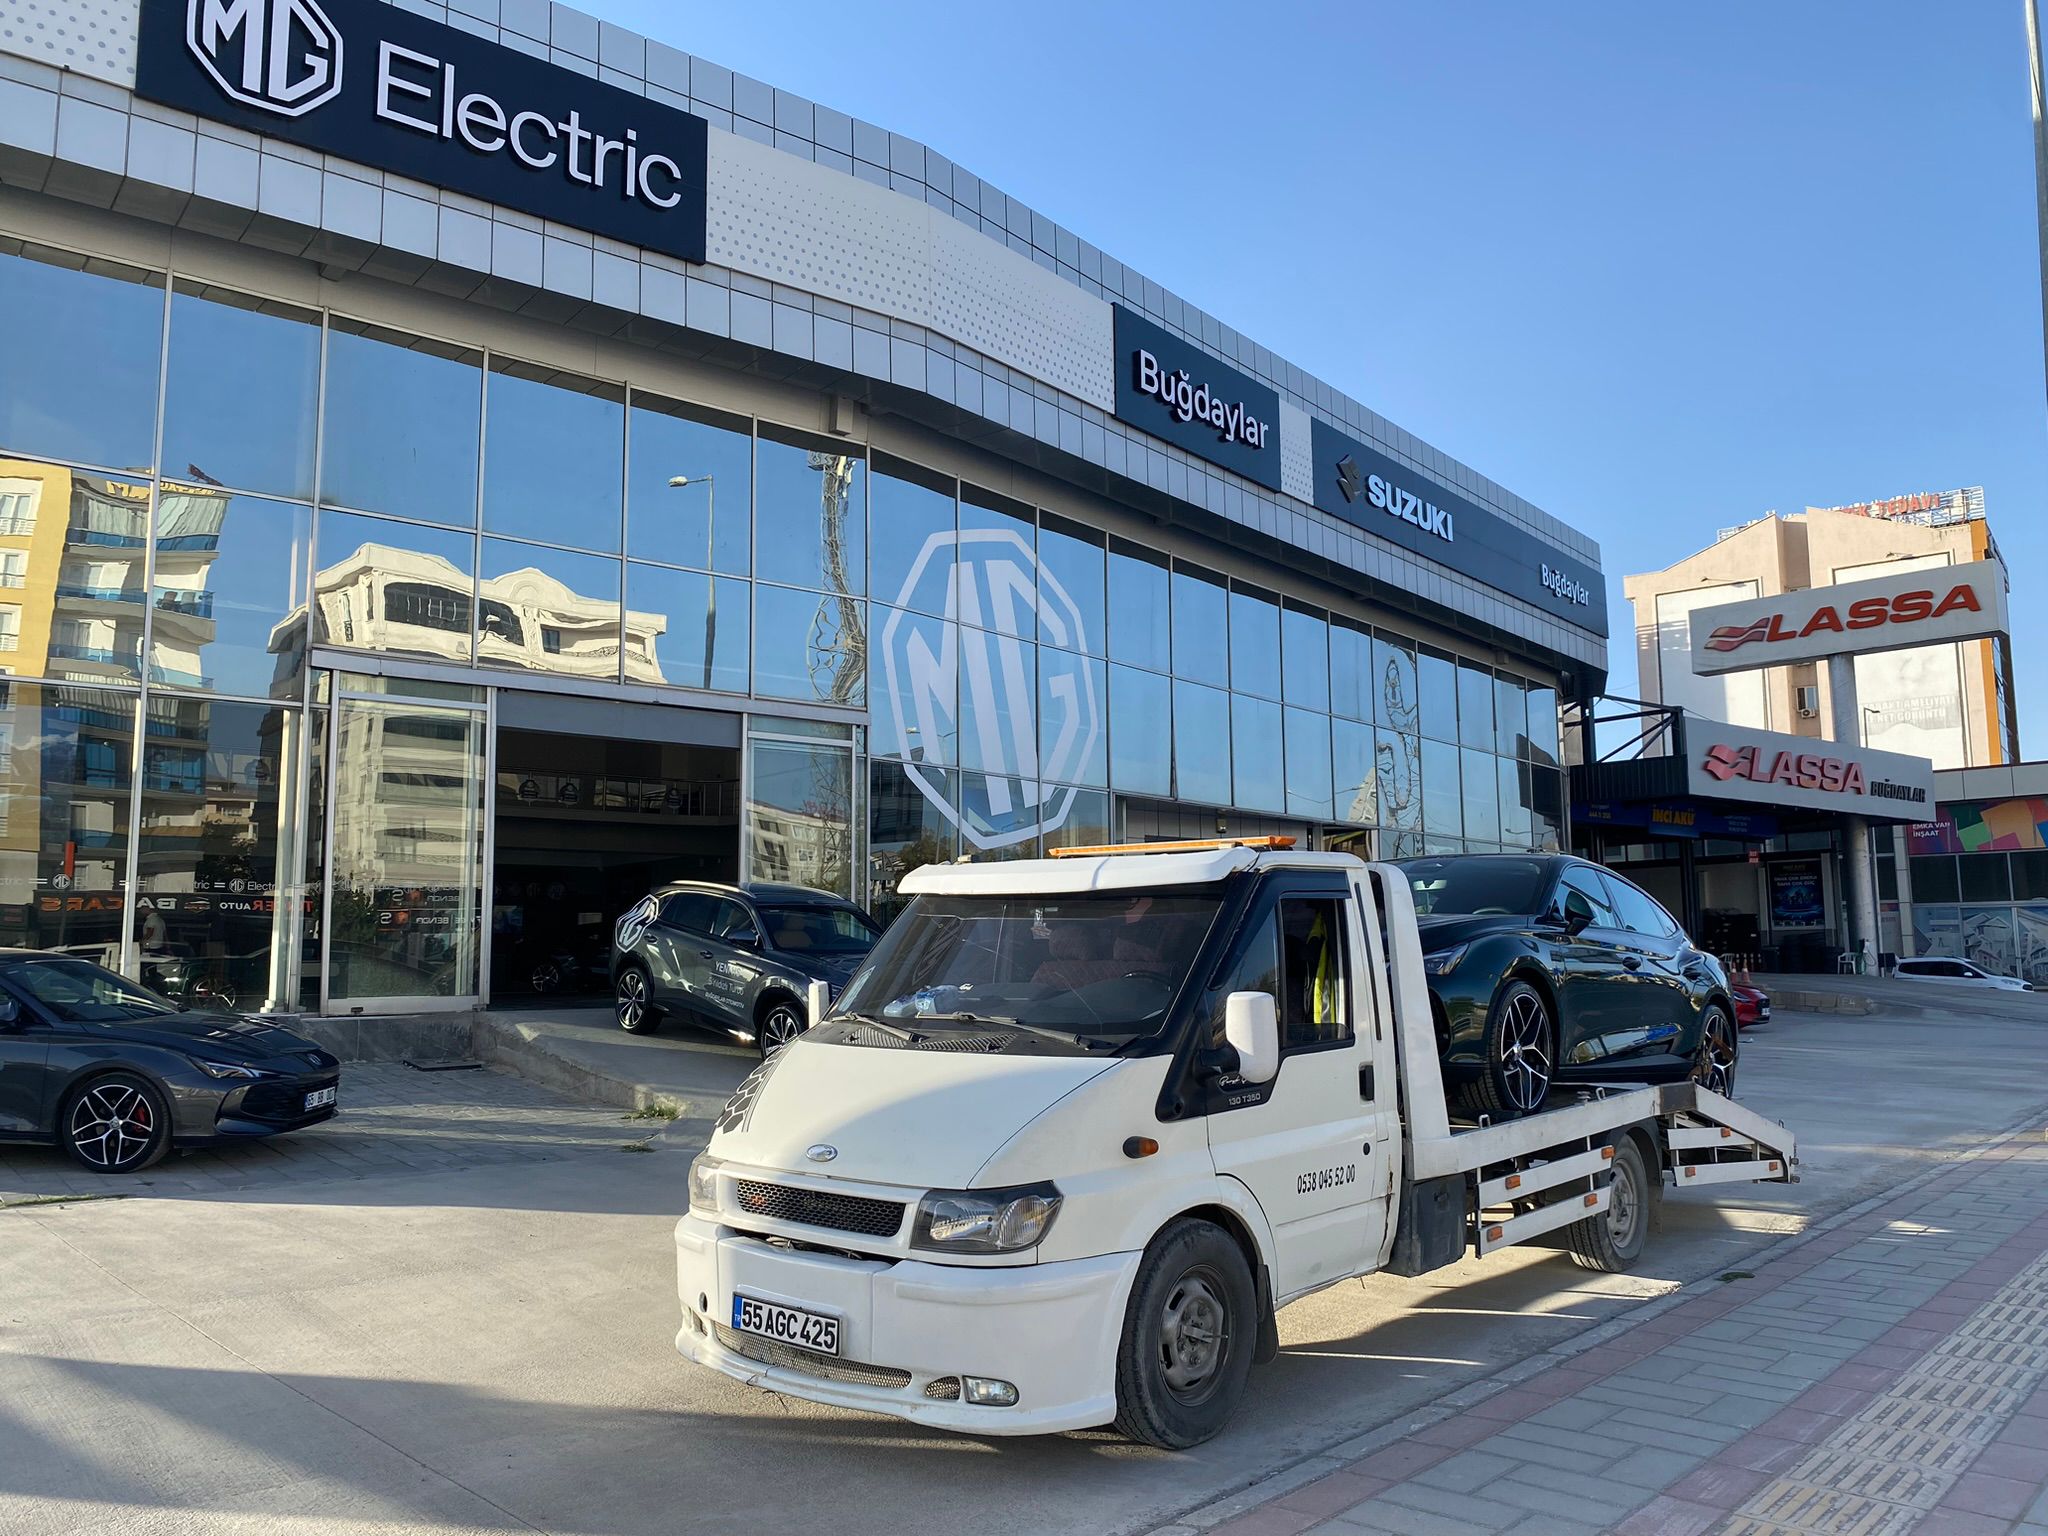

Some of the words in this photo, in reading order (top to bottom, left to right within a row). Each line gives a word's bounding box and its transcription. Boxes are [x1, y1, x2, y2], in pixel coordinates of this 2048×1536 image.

[190, 0, 340, 114] MG
[376, 40, 682, 209] Electric
[1141, 349, 1269, 449] Buğdaylar
[1368, 474, 1454, 542] SUZUKI
[1541, 563, 1589, 606] Buğdaylar
[1766, 584, 1982, 642] LASSA
[895, 545, 1090, 832] MG
[1750, 746, 1867, 795] LASSA
[1870, 779, 1927, 803] BUĞDAYLAR
[1297, 1170, 1317, 1194] 0538
[1318, 1168, 1333, 1190] 045
[1334, 1166, 1345, 1187] 52
[1345, 1163, 1356, 1183] 00
[741, 1301, 763, 1331] 55
[765, 1308, 798, 1340] AGC
[800, 1316, 836, 1349] 425
